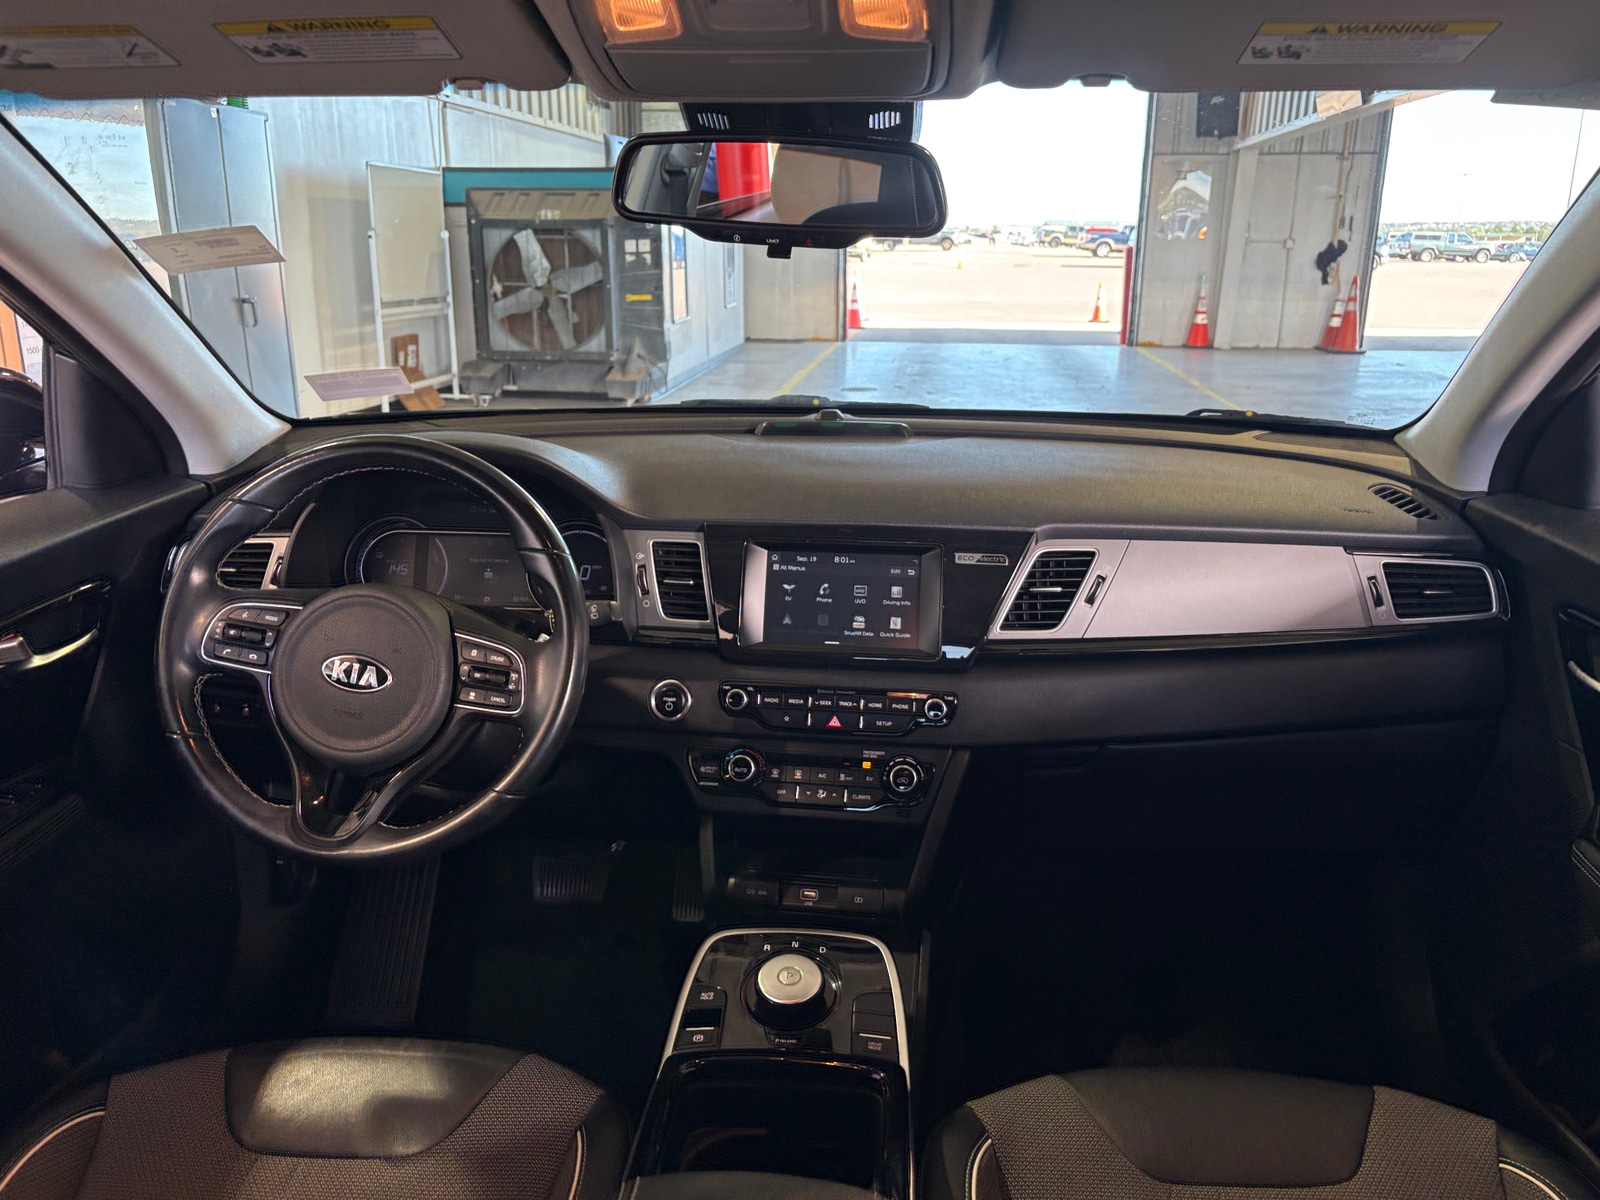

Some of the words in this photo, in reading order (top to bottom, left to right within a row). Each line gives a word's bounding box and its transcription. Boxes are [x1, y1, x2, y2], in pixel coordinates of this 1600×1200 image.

[1338, 21, 1448, 33] WARNING
[331, 659, 378, 688] KIA
[786, 972, 794, 980] P
